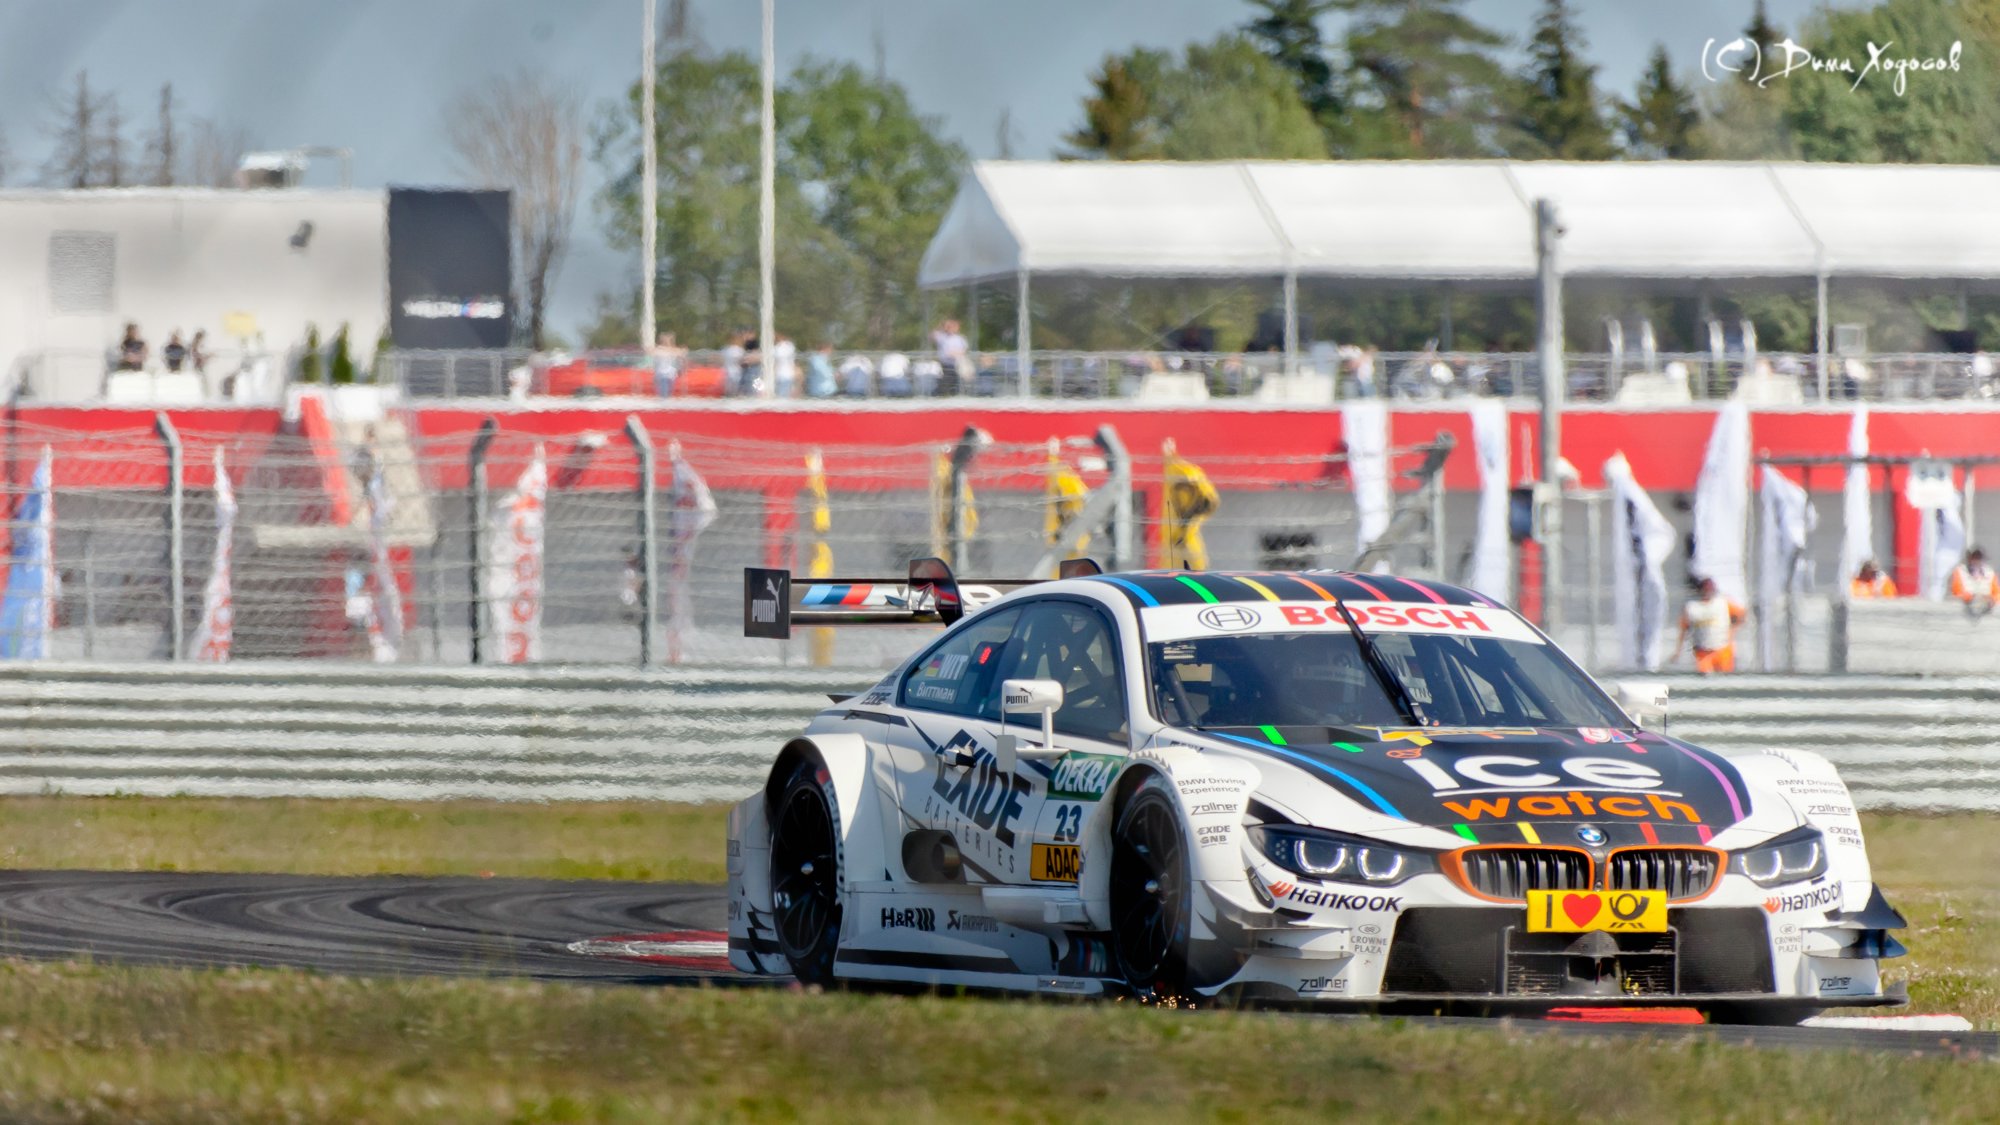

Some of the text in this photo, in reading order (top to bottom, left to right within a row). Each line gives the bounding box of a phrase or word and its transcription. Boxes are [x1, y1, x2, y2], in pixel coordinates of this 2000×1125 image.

[752, 600, 777, 623] PUMA
[1280, 606, 1491, 632] BOSCH
[938, 654, 969, 681] WIT
[916, 682, 955, 701] Виттман
[1006, 695, 1029, 704] PUMA
[1054, 758, 1111, 793] DEKRA
[1177, 778, 1246, 787] BMW Driving
[1807, 779, 1844, 788] Driving
[932, 728, 1035, 848] EXIDE
[1181, 786, 1240, 795] Experience
[1790, 787, 1847, 796] Experience
[1442, 791, 1702, 822] watch
[1053, 804, 1082, 842] 23
[925, 795, 1015, 874] BATTERIES
[1198, 825, 1231, 835] EXIDE
[1828, 827, 1858, 836] EXIDE
[1200, 835, 1227, 844] GNB
[1046, 847, 1079, 879] ADAC
[881, 907, 915, 928] H&R
[1350, 935, 1387, 945] CROWNE
[1775, 935, 1801, 945] CROWNE
[1354, 945, 1382, 954] PLAZA
[1778, 944, 1798, 953] PLAZA
